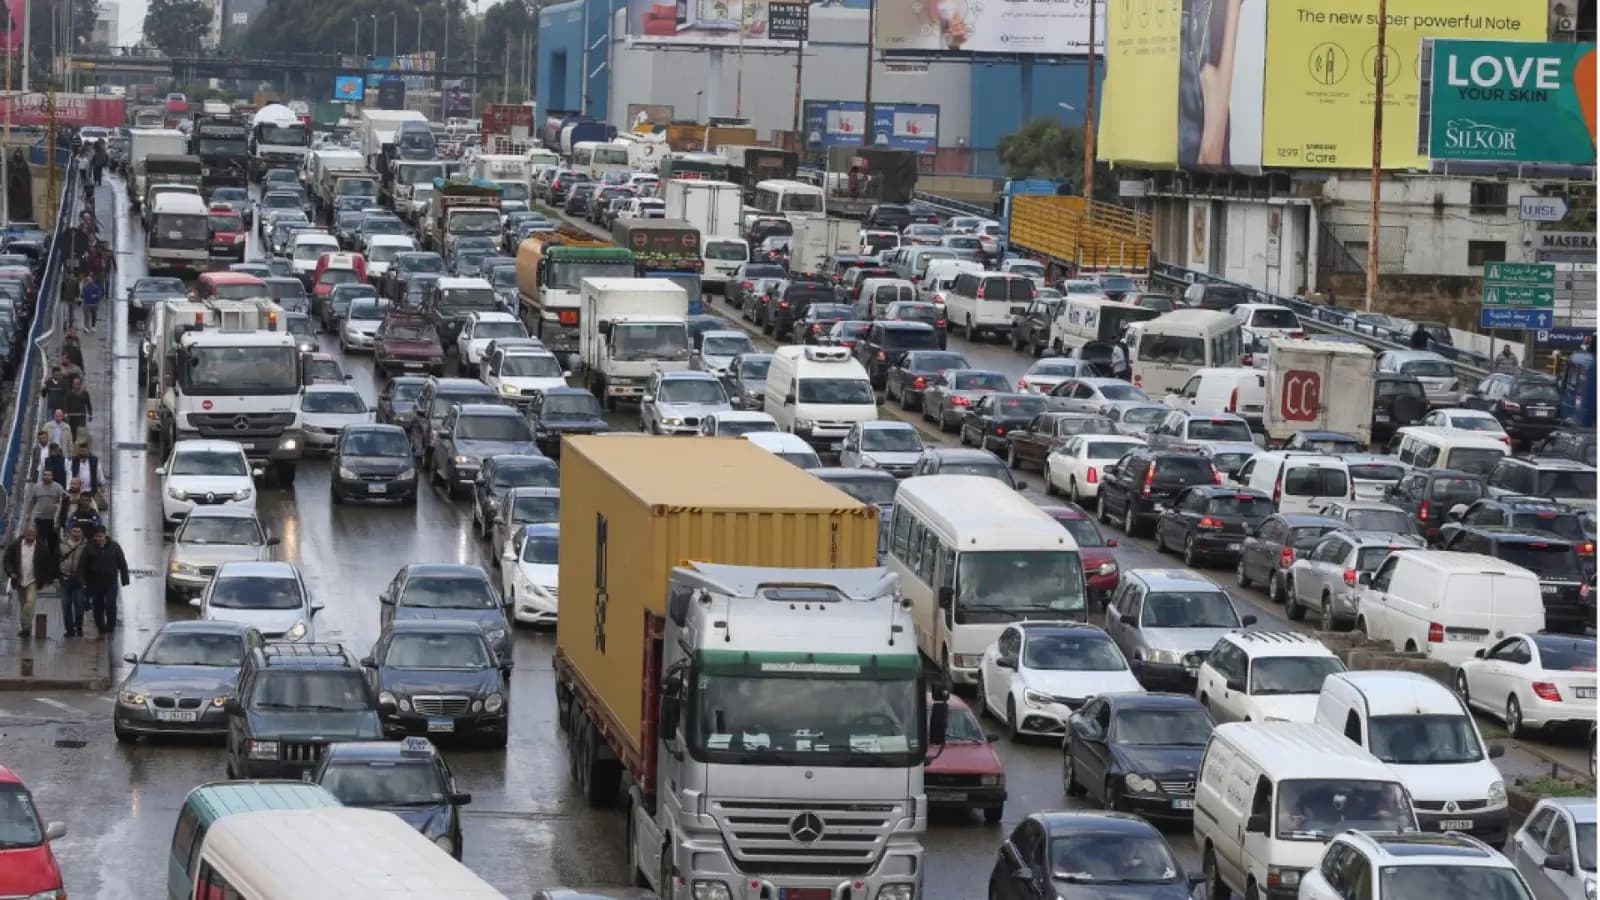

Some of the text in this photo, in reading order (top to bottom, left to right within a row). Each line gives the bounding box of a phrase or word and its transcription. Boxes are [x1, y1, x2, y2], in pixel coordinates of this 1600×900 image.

[1297, 9, 1326, 24] The
[1329, 13, 1363, 25] new
[1414, 14, 1482, 30] powerful
[1485, 17, 1521, 31] Note
[1448, 54, 1561, 89] LOVE
[1458, 87, 1548, 103] YOUR SKIN
[1305, 152, 1337, 164] Care
